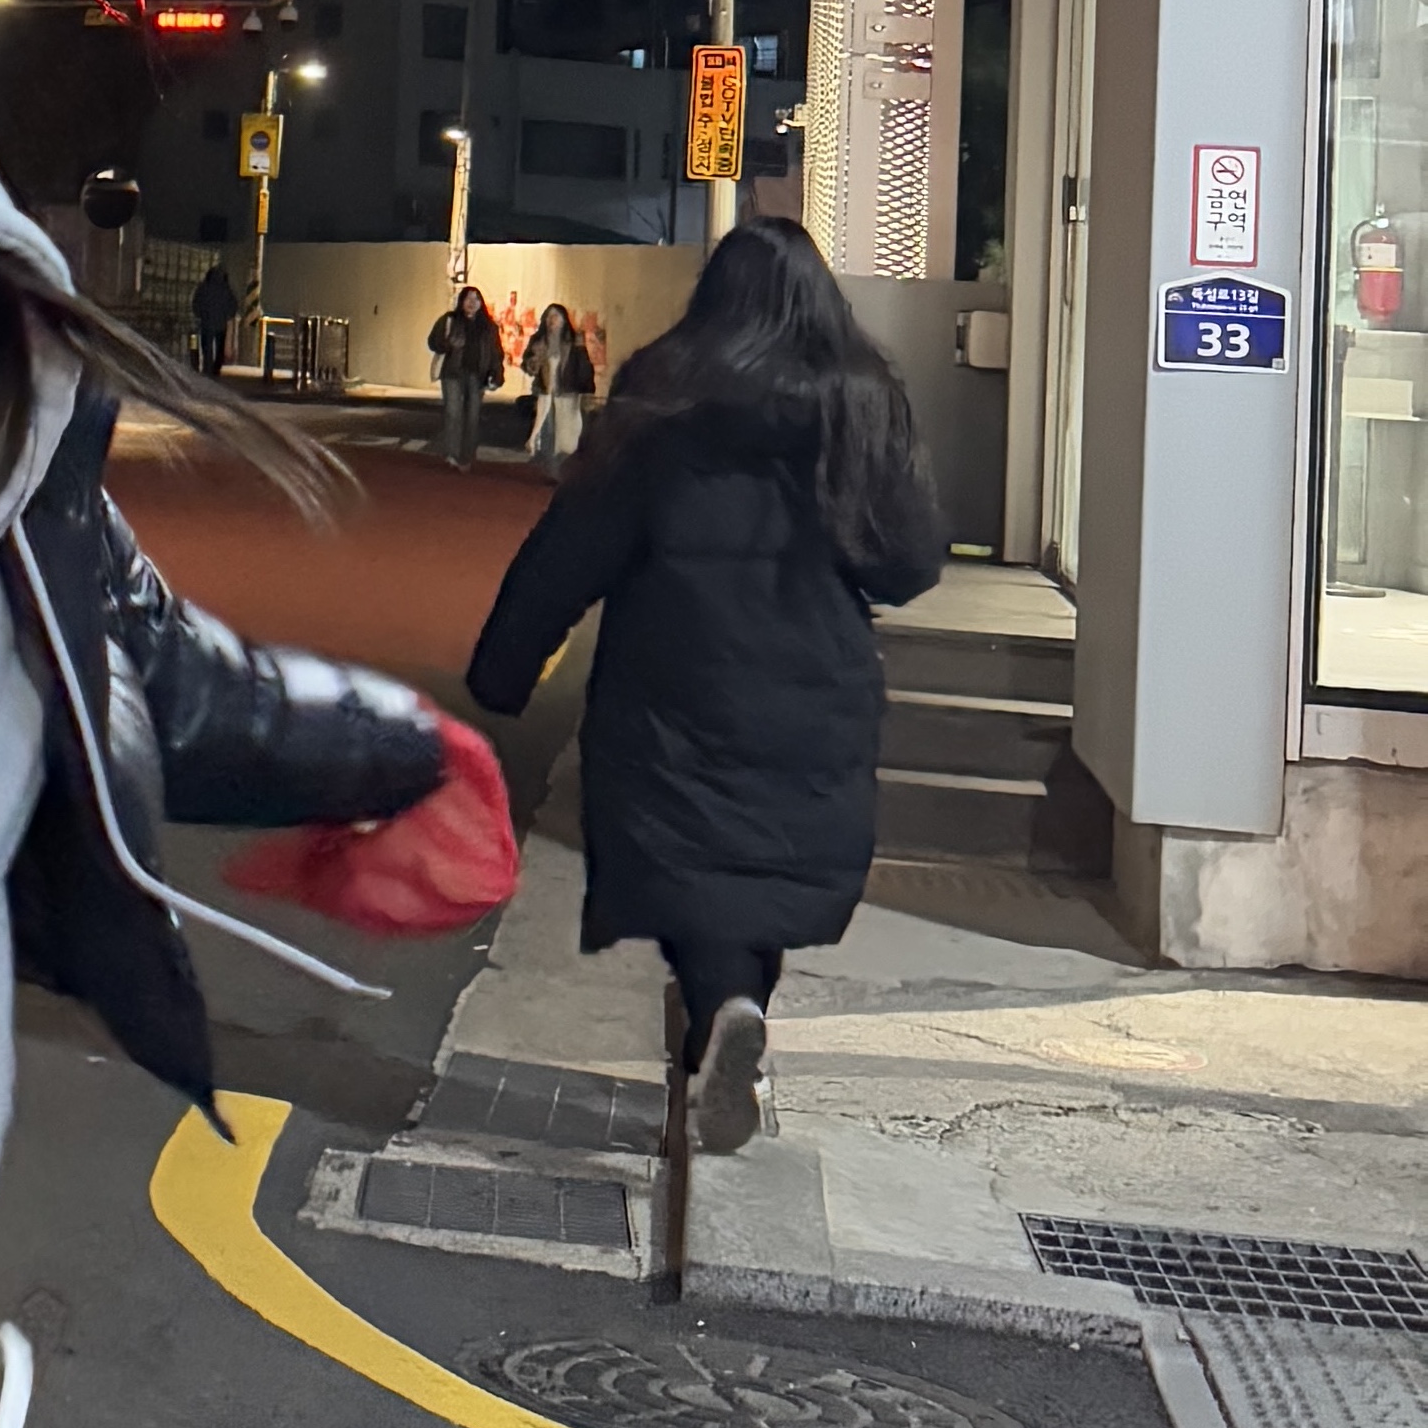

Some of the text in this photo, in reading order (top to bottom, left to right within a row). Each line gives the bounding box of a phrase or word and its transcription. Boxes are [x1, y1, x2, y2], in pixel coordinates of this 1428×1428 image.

[1207, 189, 1247, 209] 금연
[1206, 213, 1246, 233] 구역
[1197, 322, 1250, 358] 33
